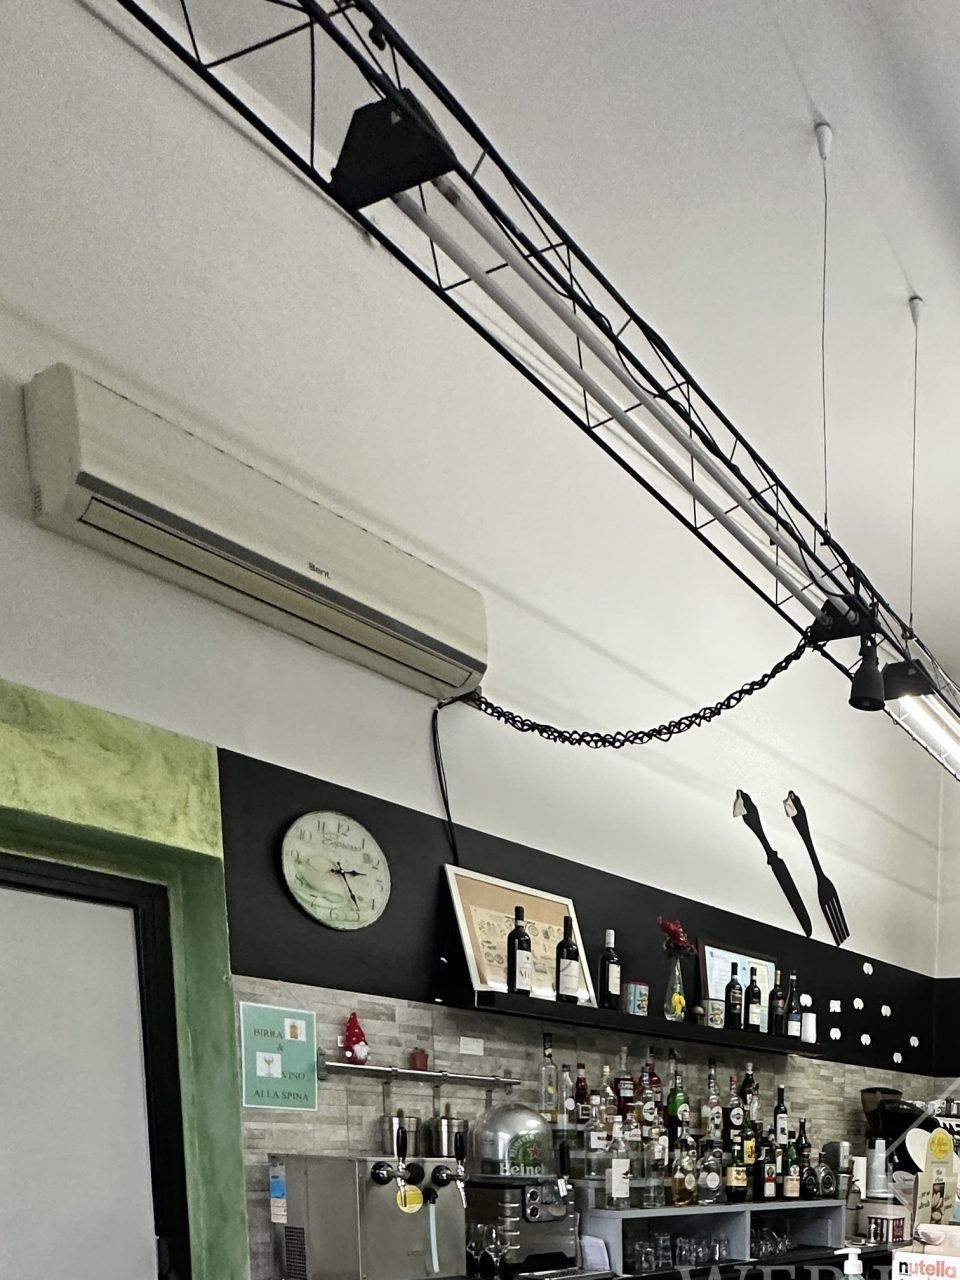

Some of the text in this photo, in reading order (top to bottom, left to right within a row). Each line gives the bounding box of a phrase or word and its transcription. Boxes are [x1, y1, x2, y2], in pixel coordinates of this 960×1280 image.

[253, 1028, 284, 1039] BIRRA
[281, 1071, 306, 1081] VINO
[253, 1089, 309, 1101] ALLA SPINA
[898, 1260, 957, 1279] nutella
